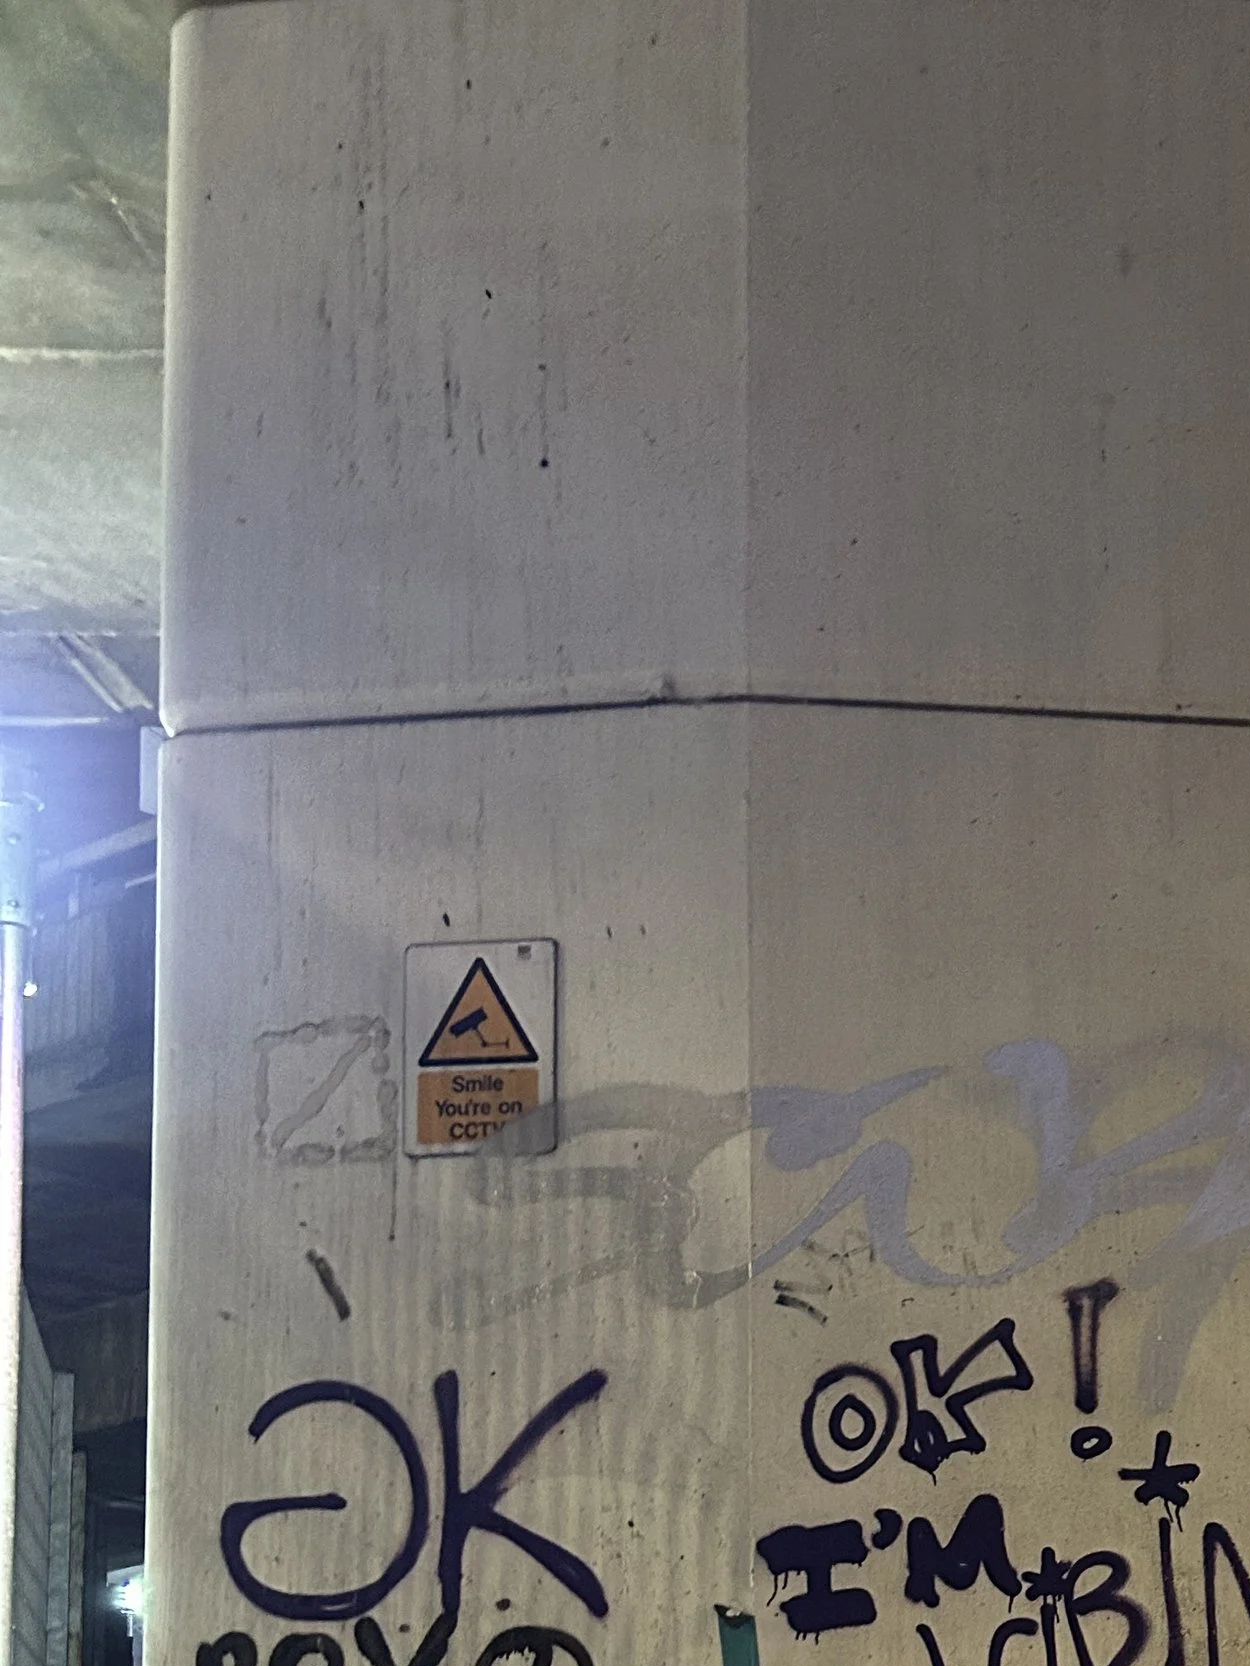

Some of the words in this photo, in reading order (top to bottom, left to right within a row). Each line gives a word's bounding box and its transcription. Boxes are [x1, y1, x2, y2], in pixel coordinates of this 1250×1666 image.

[452, 1075, 504, 1093] Smile
[435, 1099, 491, 1118] You're
[498, 1100, 522, 1113] on
